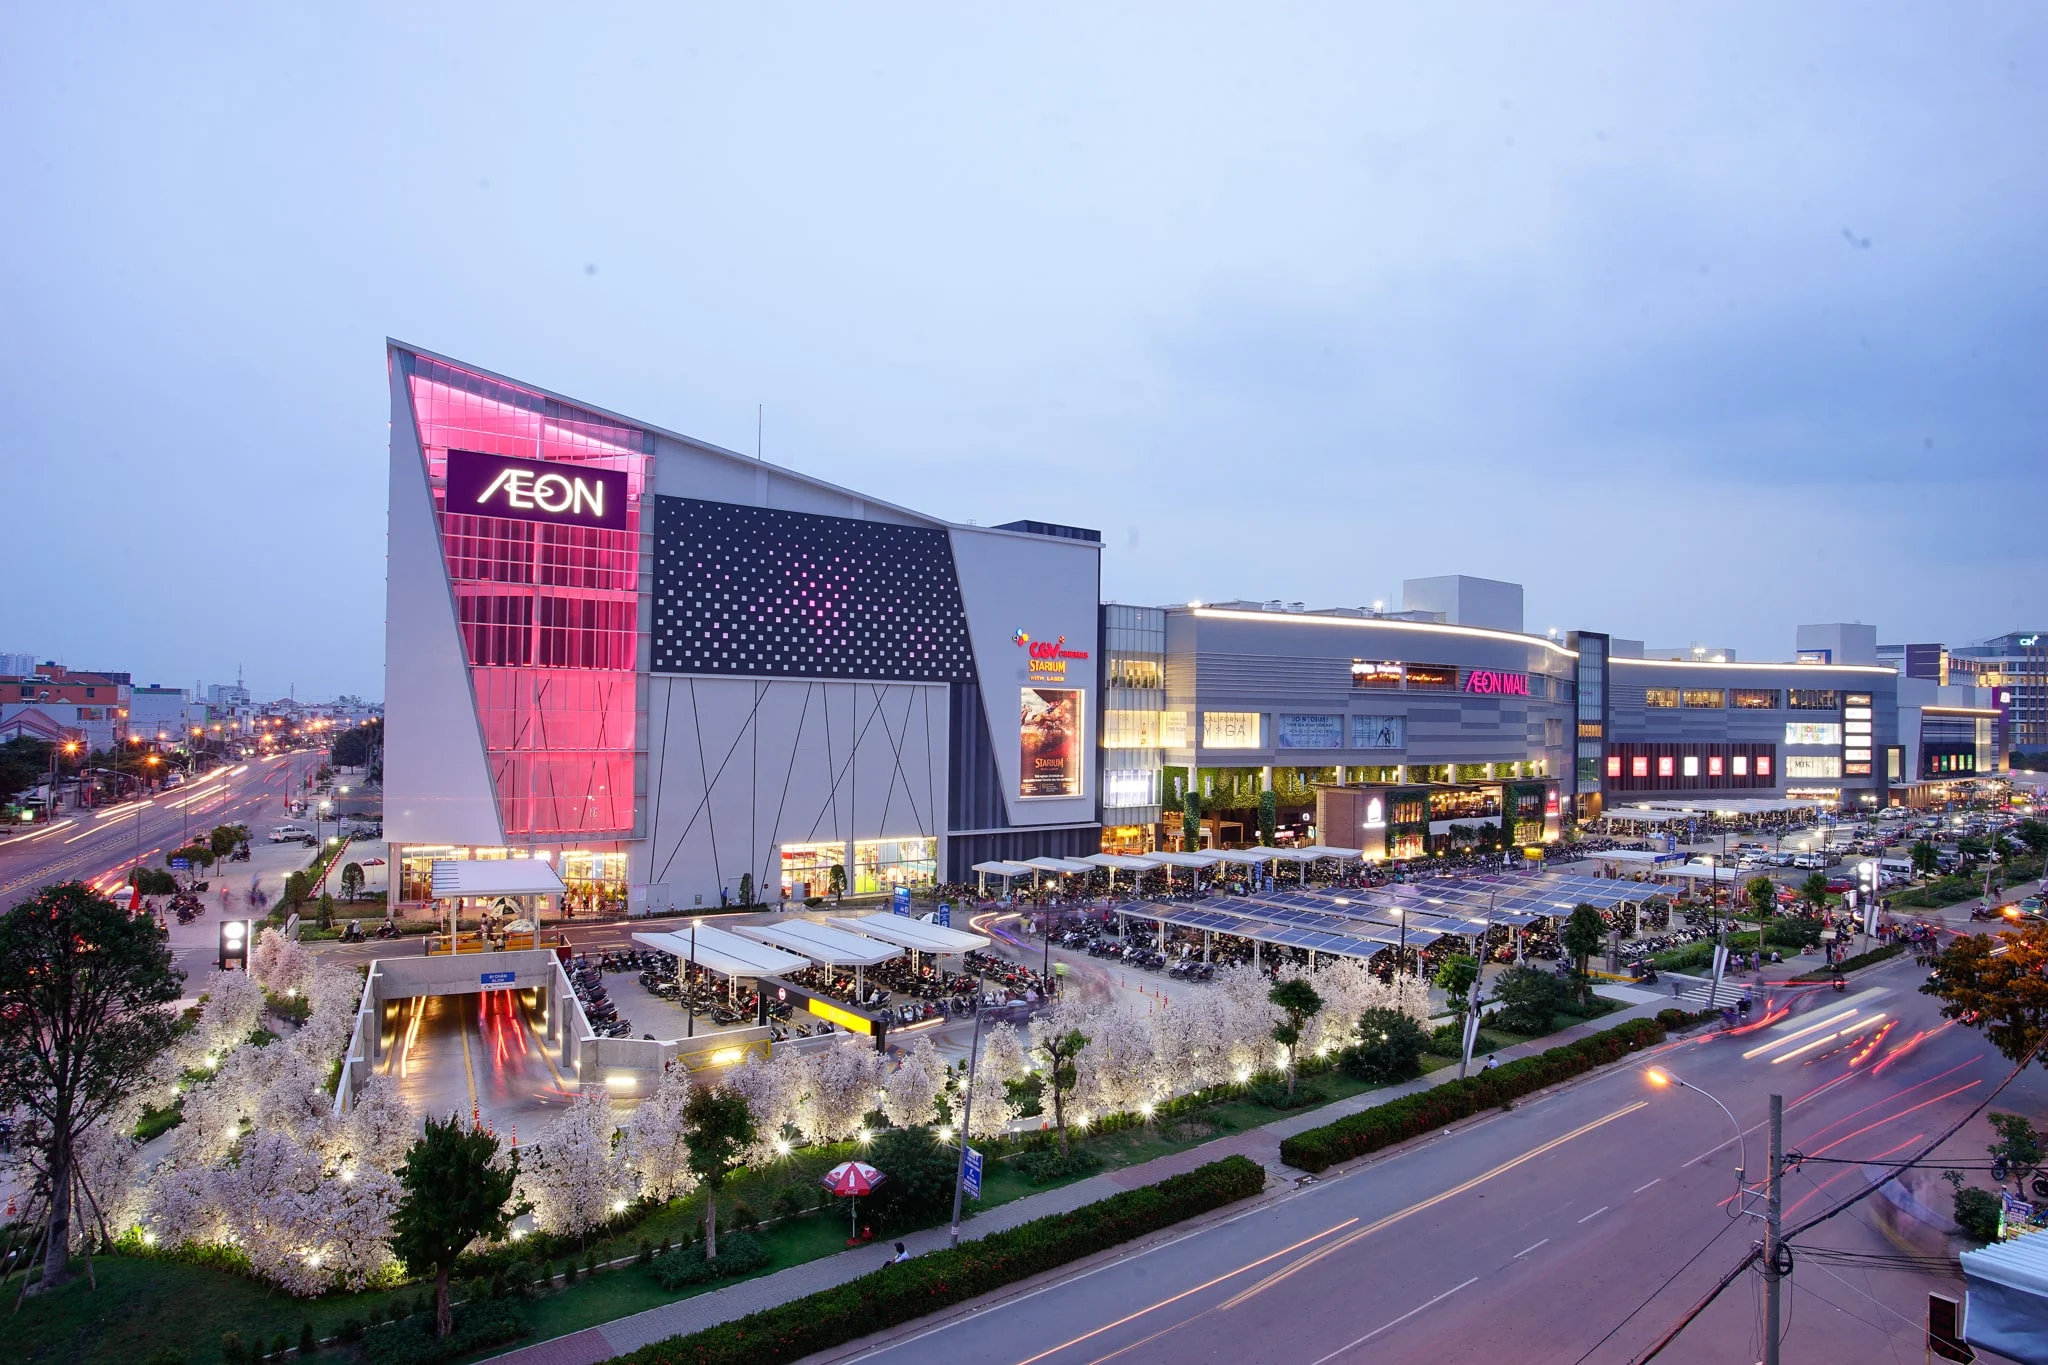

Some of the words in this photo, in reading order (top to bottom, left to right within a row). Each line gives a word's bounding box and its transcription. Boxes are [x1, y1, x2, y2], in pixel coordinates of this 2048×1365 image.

[1029, 641, 1060, 658] CGV
[1029, 660, 1066, 673] STARIUM
[1503, 673, 1530, 696] MALL
[1035, 758, 1064, 768] STARIUM
